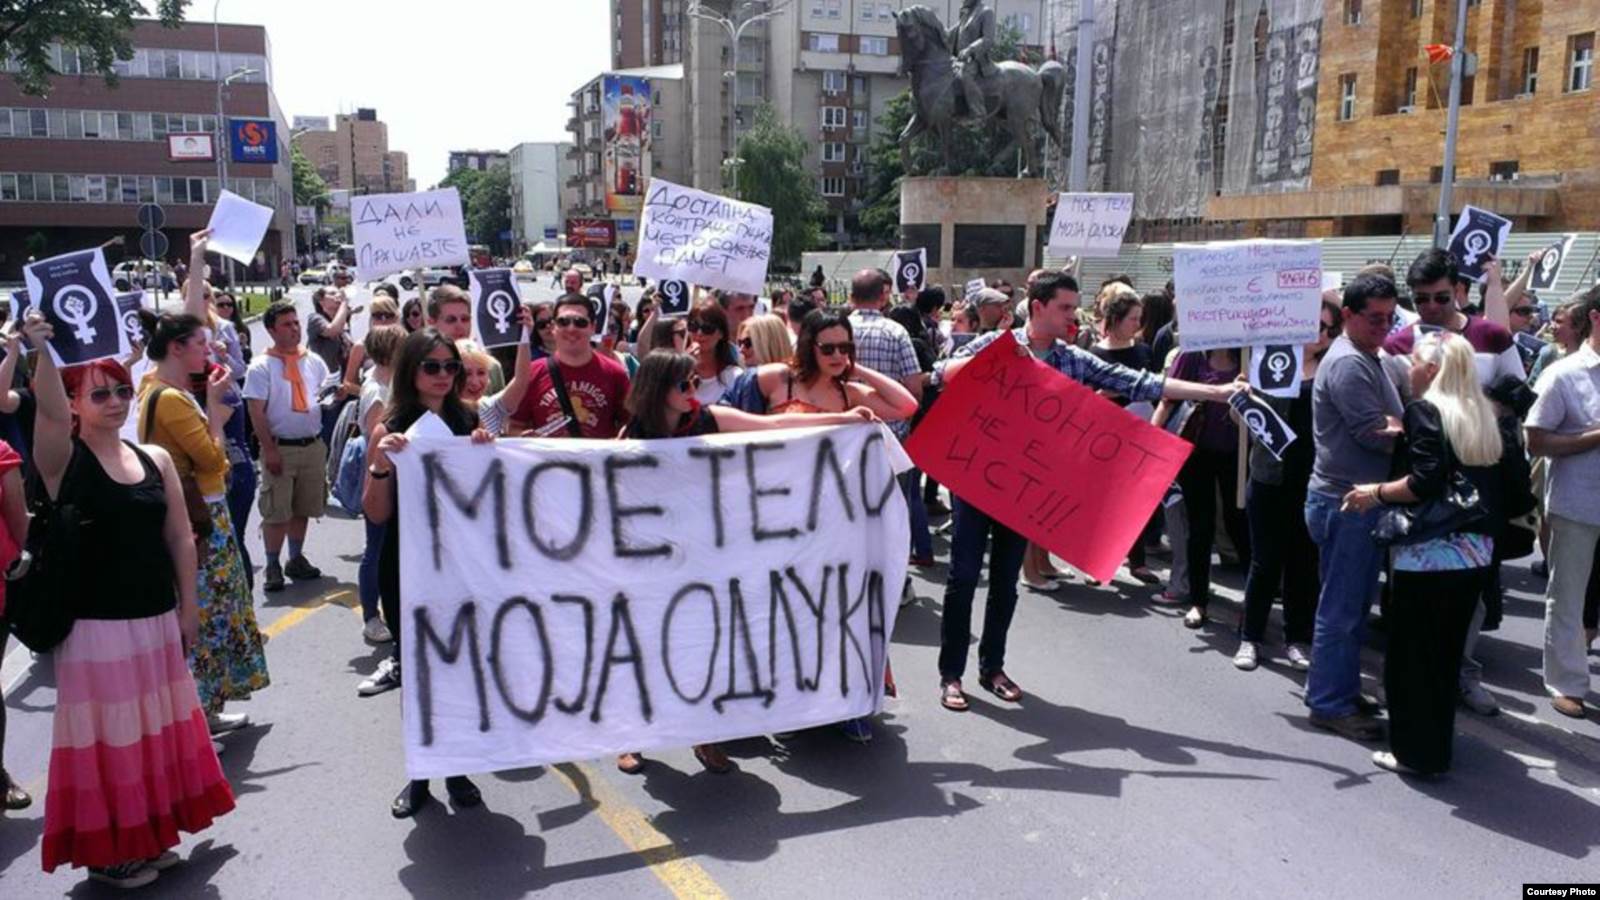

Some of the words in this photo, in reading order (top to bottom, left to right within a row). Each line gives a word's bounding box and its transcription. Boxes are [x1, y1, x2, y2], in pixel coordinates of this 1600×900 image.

[356, 200, 444, 226] ДАЛИ
[647, 186, 757, 222] ДОСТАПНА
[393, 226, 422, 241] НЕ
[645, 223, 705, 247] МЕСТО
[359, 238, 459, 269] ПРАШАВТЕ
[659, 247, 738, 274] ПАМЕТ
[1307, 270, 1317, 285] 6
[571, 381, 608, 408] AMIGOS
[967, 405, 1008, 442] НЕ
[421, 449, 674, 573] МОЕ
[688, 431, 898, 549] ТЕЛО
[412, 590, 655, 748] МОЈА
[659, 562, 887, 715] ОДЛУКА
